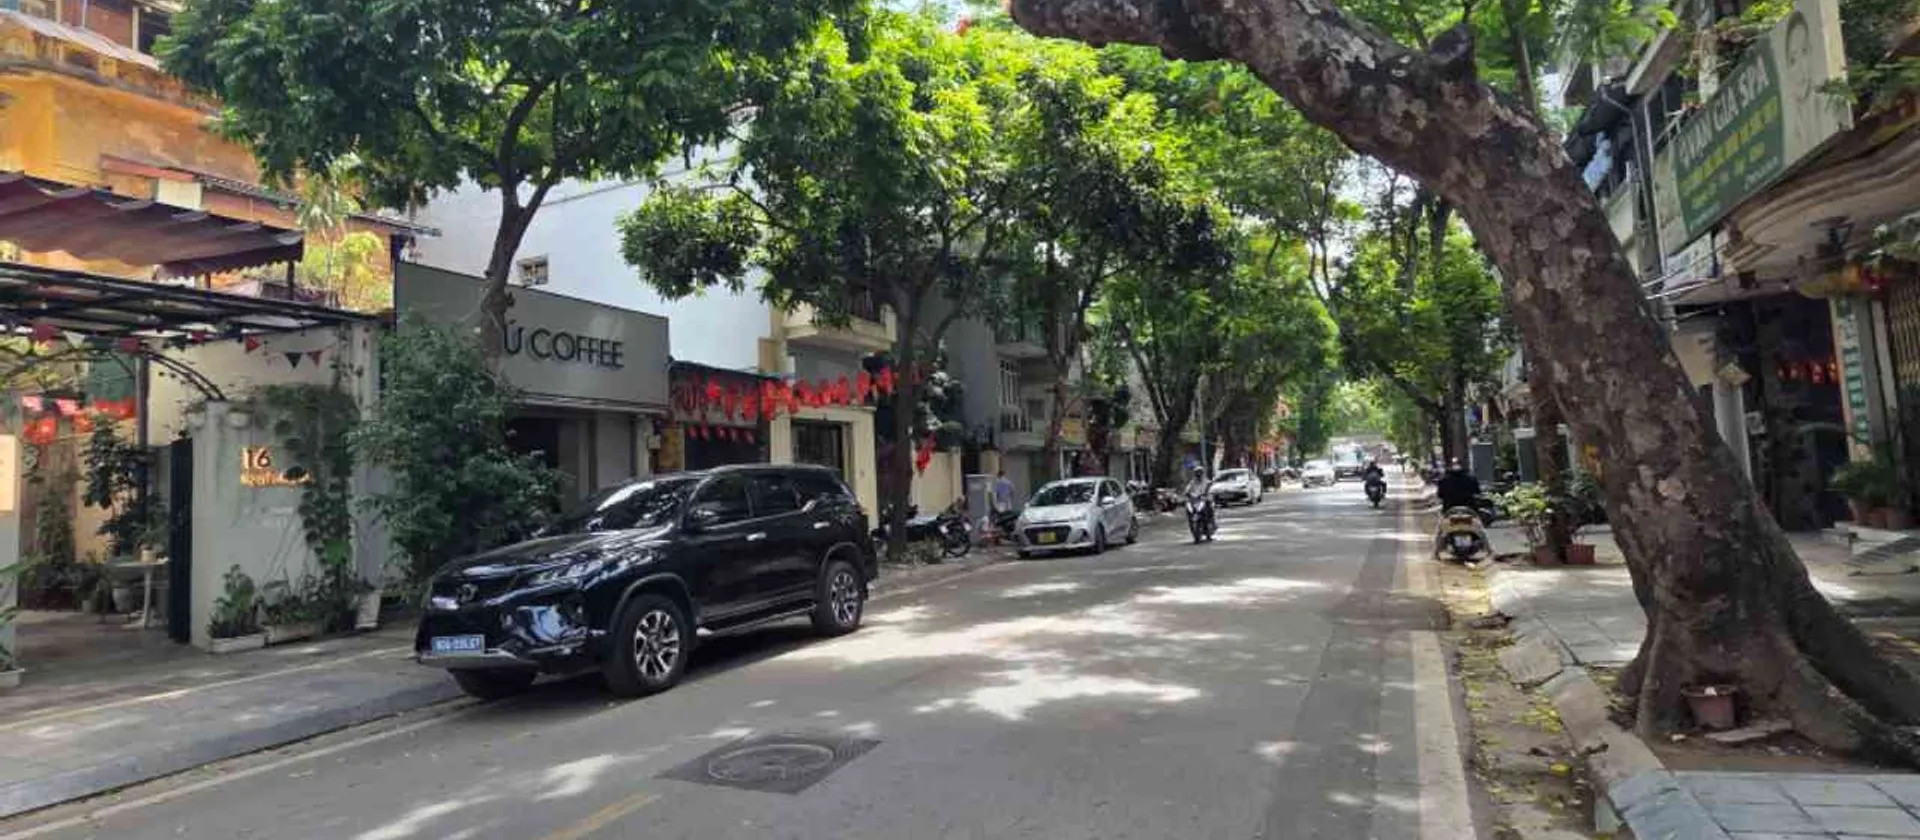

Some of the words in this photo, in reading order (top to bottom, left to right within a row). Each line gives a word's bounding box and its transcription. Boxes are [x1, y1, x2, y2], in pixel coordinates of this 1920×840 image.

[1714, 88, 1739, 131] GIA
[1739, 55, 1769, 106] SPA
[530, 327, 625, 368] COFFEE
[246, 449, 271, 468] 16
